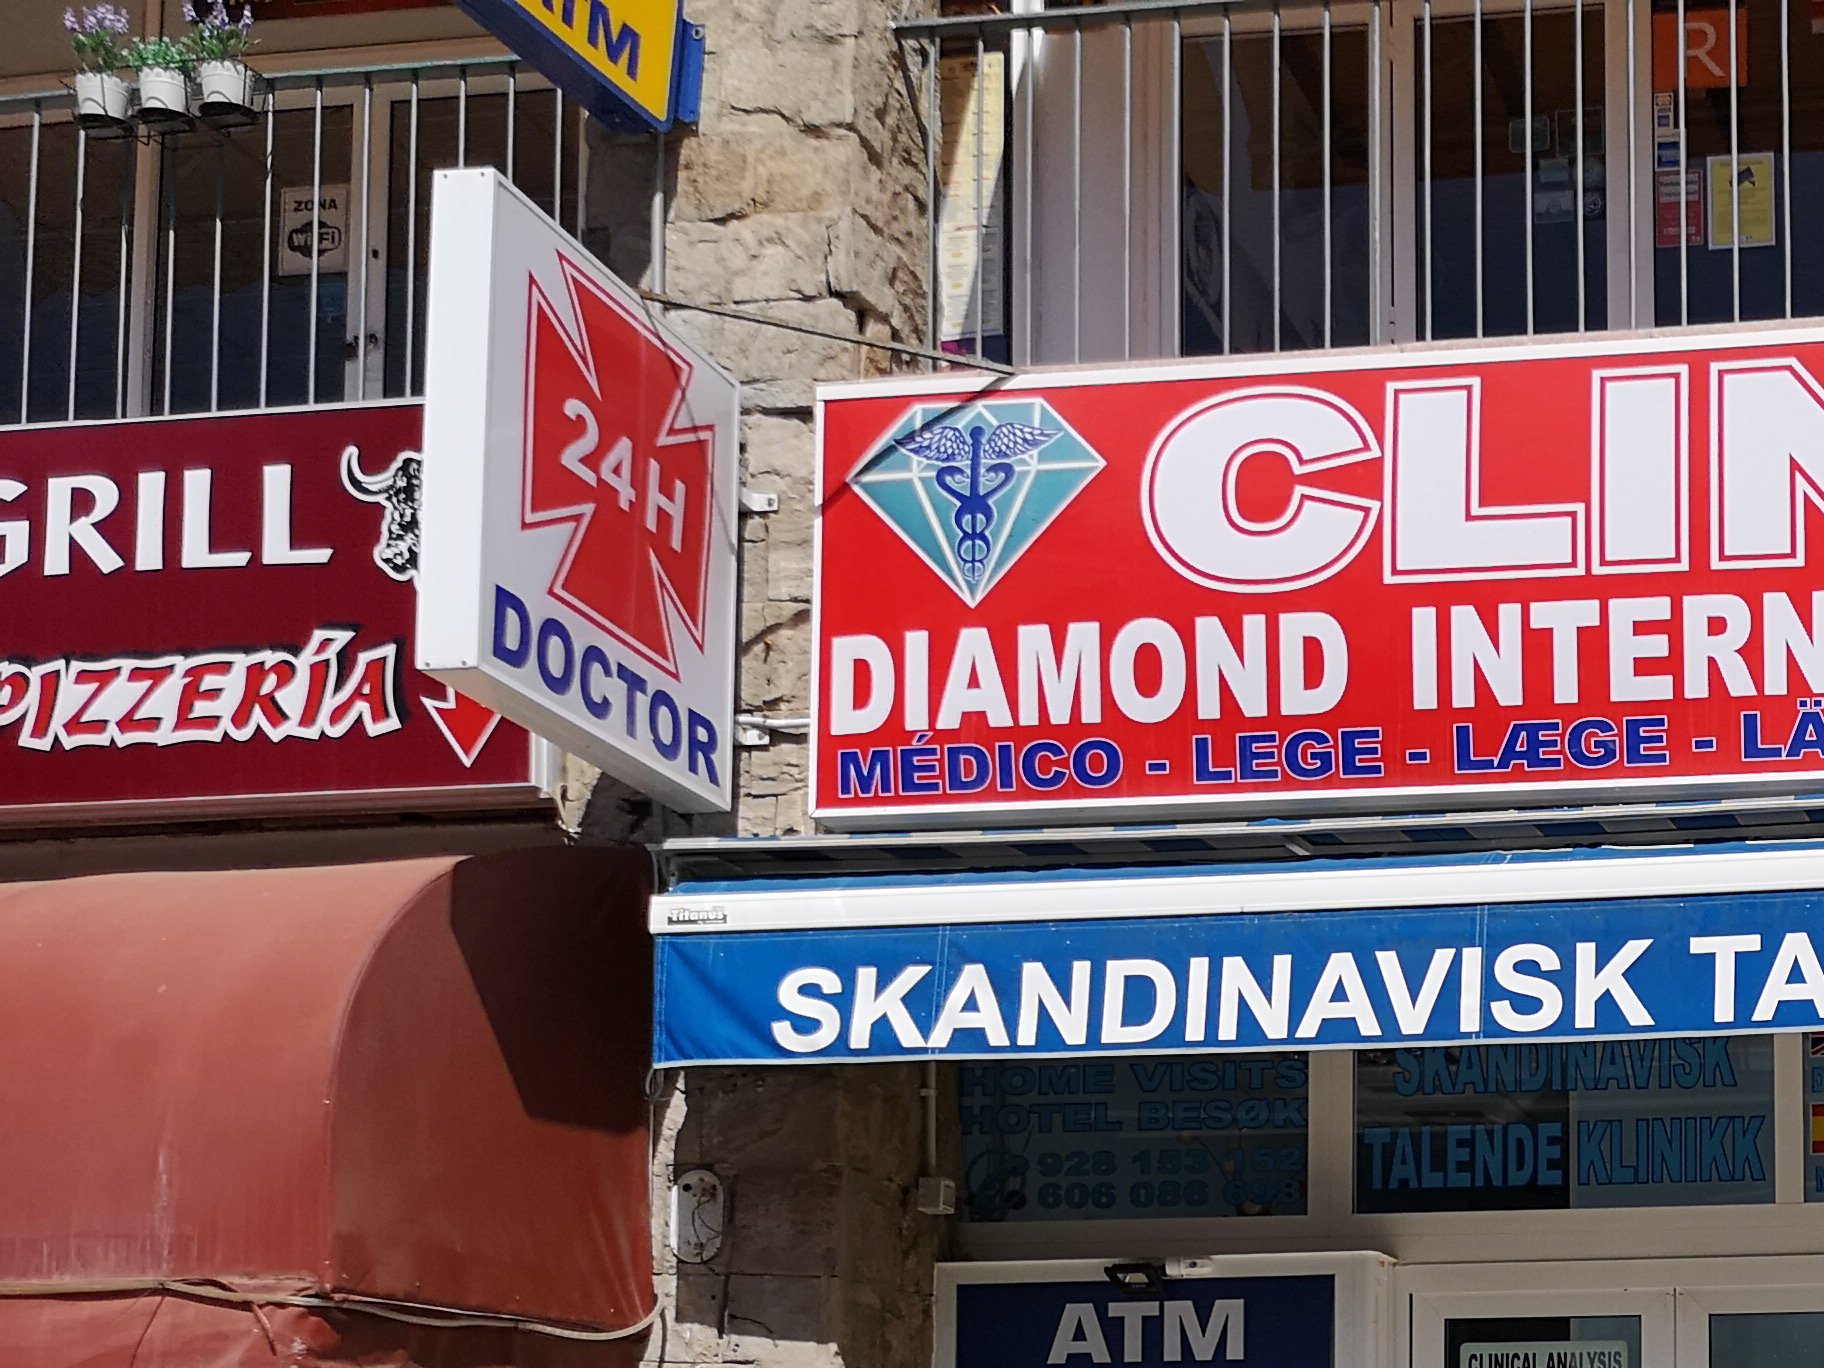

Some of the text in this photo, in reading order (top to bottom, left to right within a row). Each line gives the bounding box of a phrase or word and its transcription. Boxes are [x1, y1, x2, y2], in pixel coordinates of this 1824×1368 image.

[494, 583, 721, 786] DOCTOR
[830, 610, 1349, 736] DIAMOND
[836, 731, 1124, 797] MÉDICO
[1192, 728, 1385, 785] LEGE
[1454, 715, 1671, 773] LÆGE
[769, 937, 1656, 1054] SKANDINAVISK
[961, 1058, 1307, 1097] HOME VISITS
[1392, 1037, 1737, 1097] SKANDINAVISK
[961, 1098, 1308, 1135] HOTEL BESØK
[1037, 1151, 1118, 1178] 928
[1132, 1148, 1209, 1176] 153
[1364, 1115, 1767, 1191] TALENDE KLINIKK
[1037, 1178, 1302, 1210] 606 086 698
[1046, 1298, 1245, 1365] ATM
